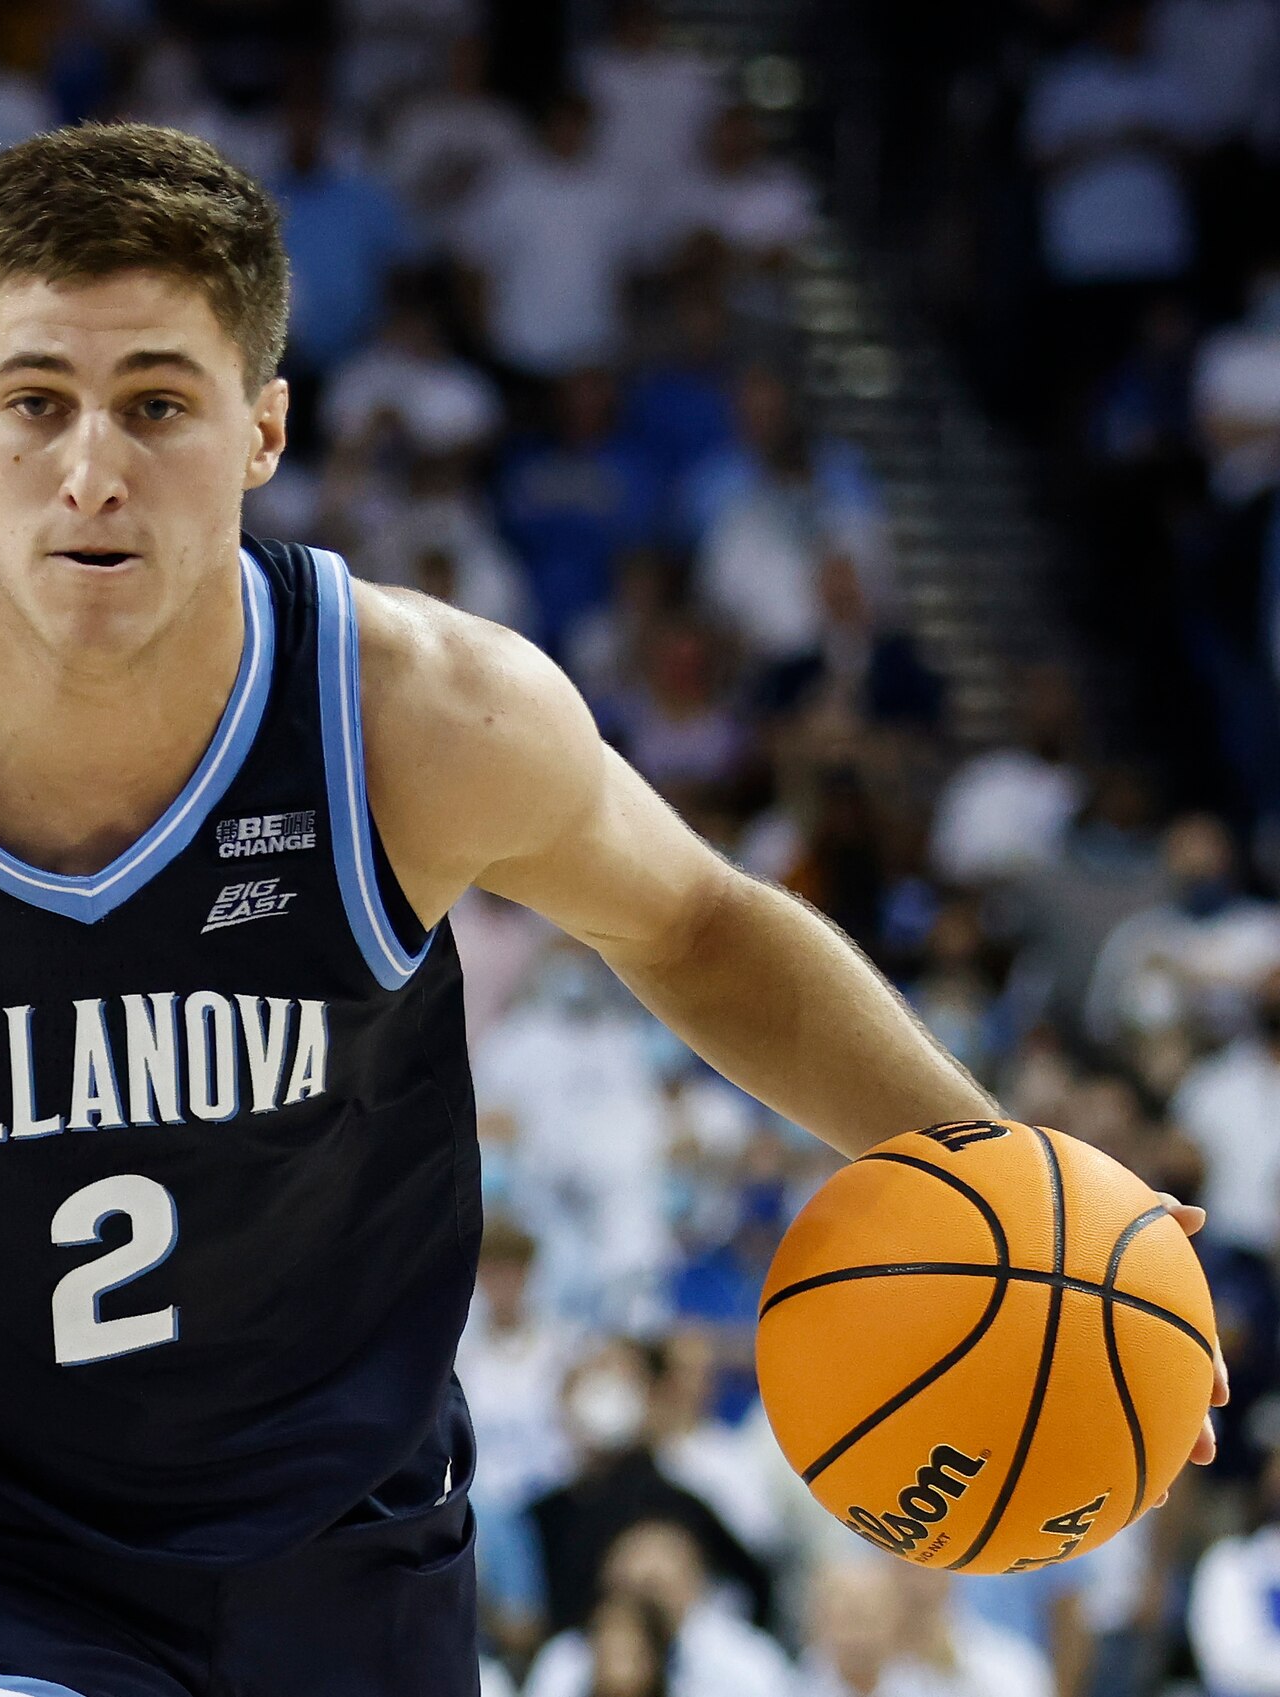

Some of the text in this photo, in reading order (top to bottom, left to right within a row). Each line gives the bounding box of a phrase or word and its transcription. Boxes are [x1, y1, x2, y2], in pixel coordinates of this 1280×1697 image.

[218, 833, 317, 858] CHANGE
[215, 877, 281, 904] BIG
[207, 893, 298, 923] EAST
[51, 1174, 179, 1367] 2
[835, 1443, 987, 1558] ilson
[928, 1532, 951, 1552] NXT
